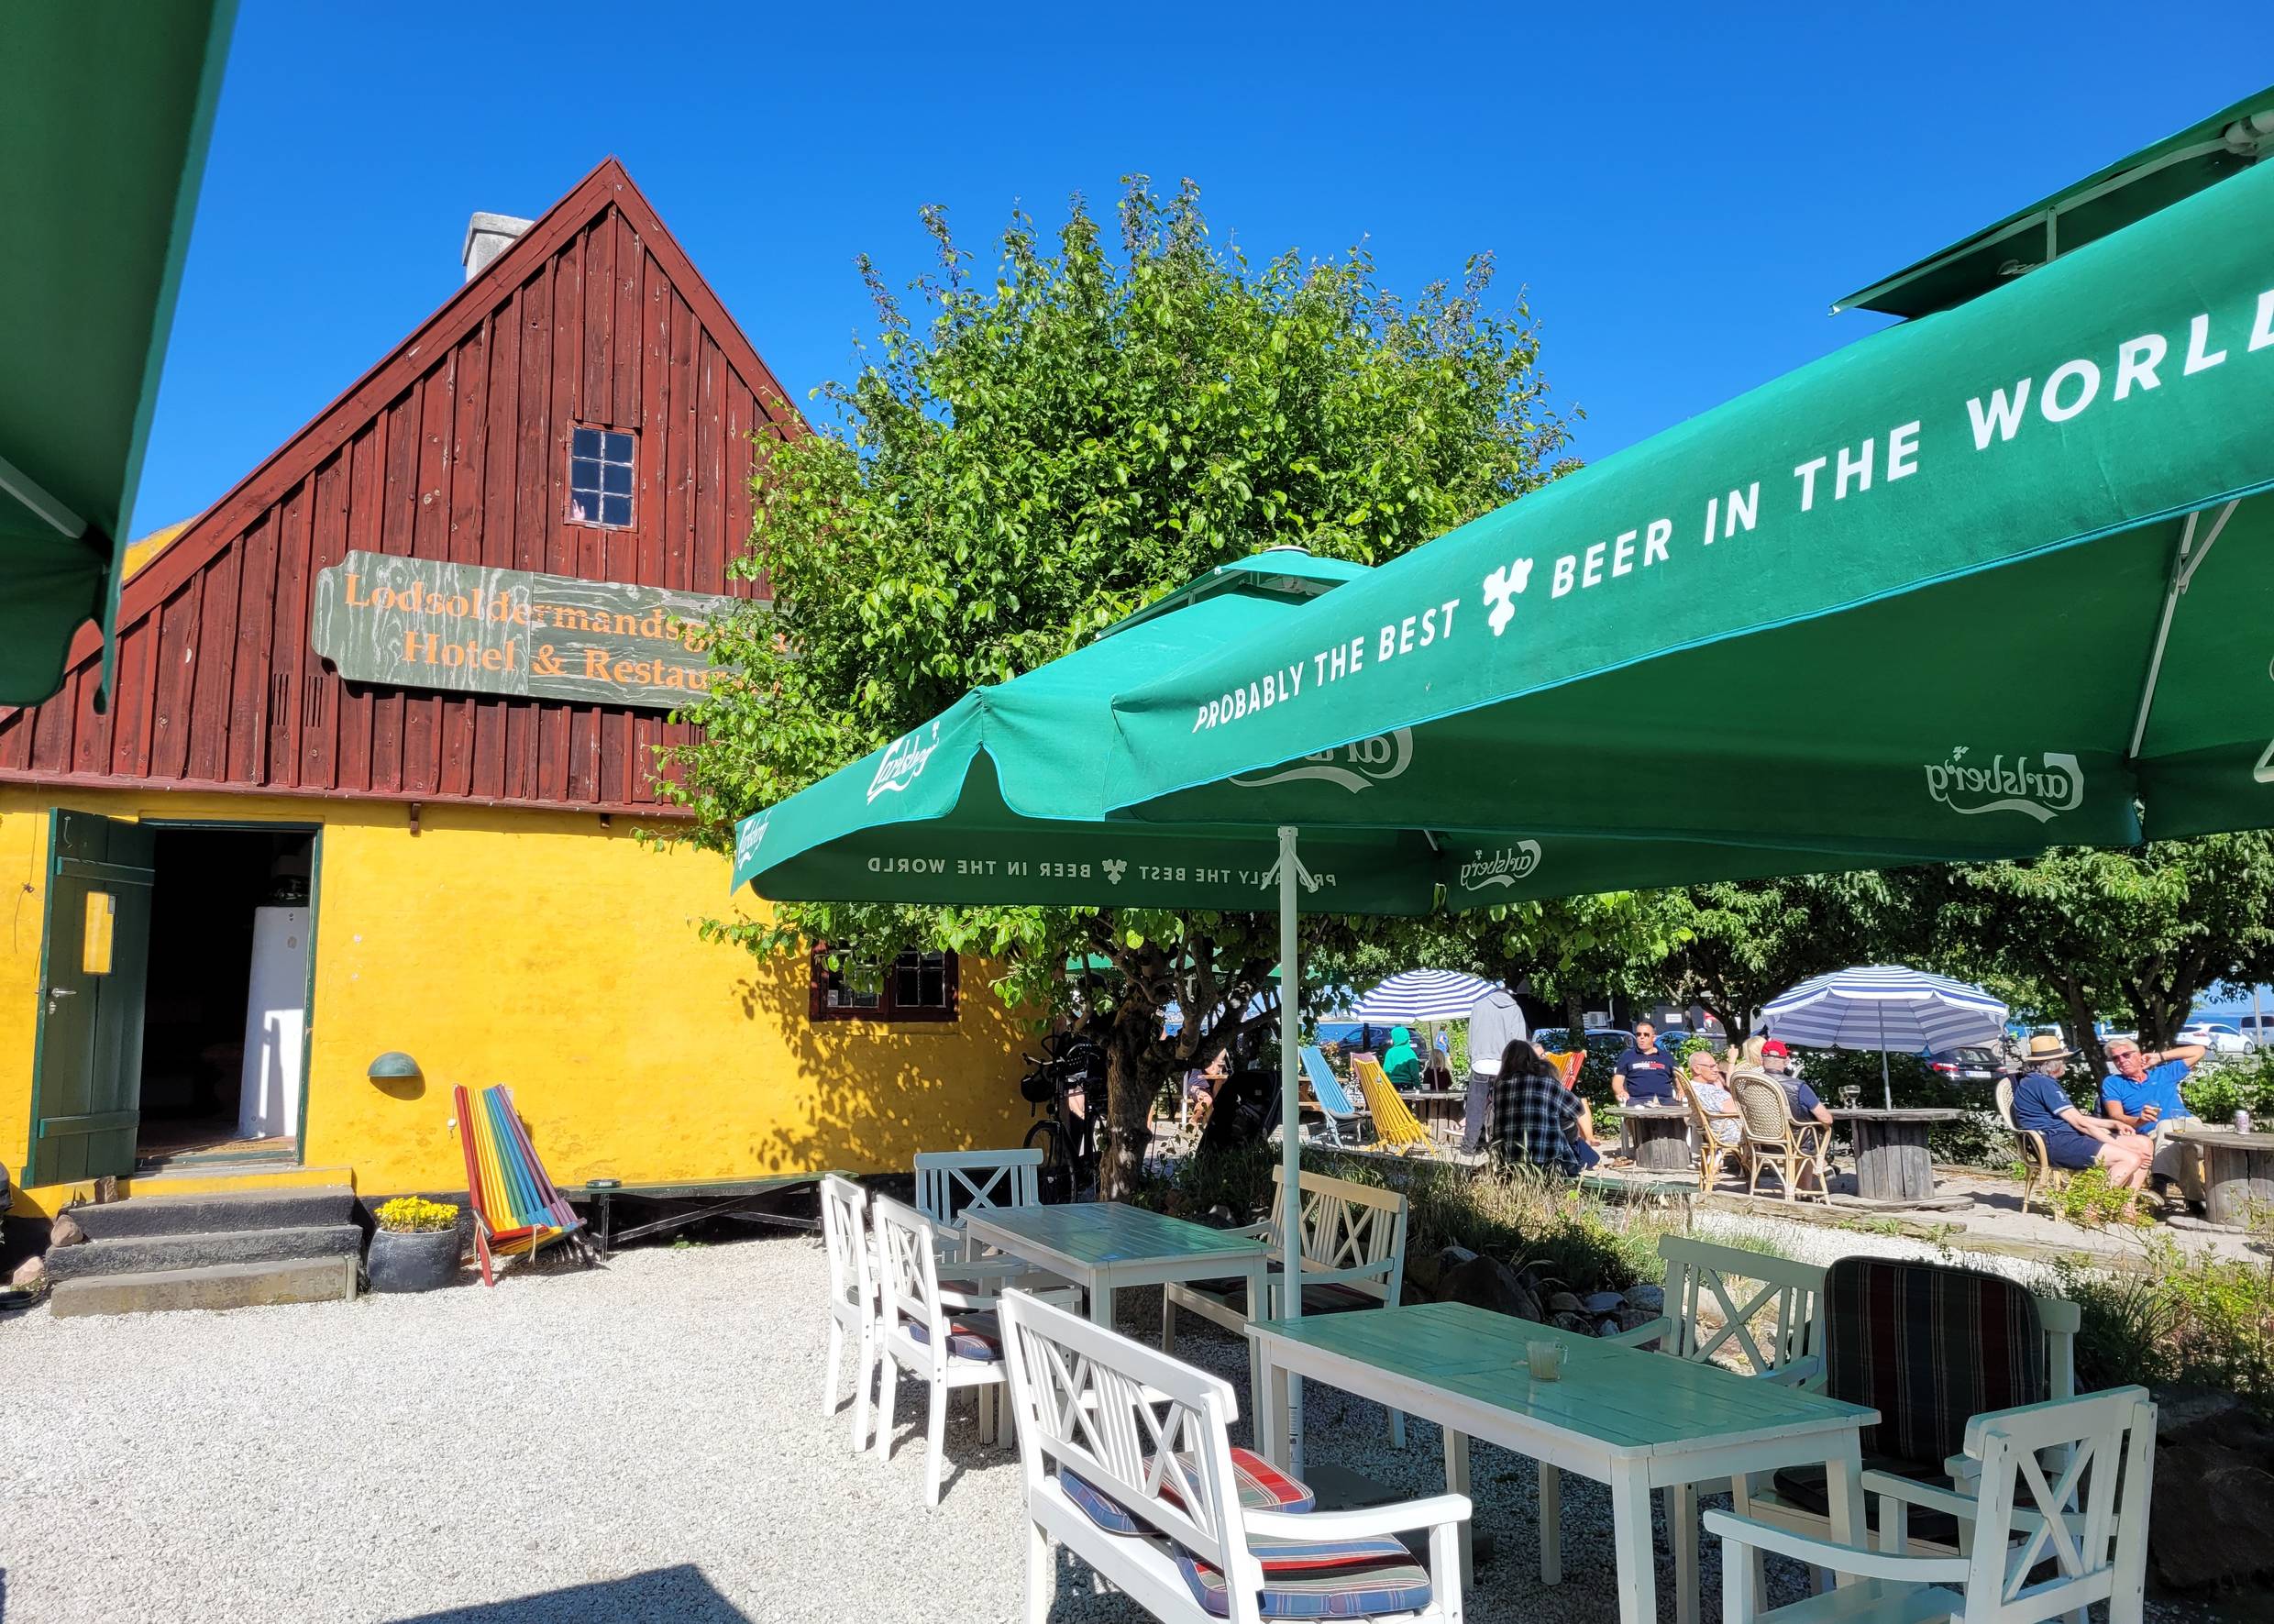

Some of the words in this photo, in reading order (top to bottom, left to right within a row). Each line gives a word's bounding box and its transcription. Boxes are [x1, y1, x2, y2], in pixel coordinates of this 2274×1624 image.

[402, 630, 515, 672] Hotel
[533, 644, 567, 676] &
[584, 647, 783, 696] Restau
[1191, 661, 1304, 734] PROBABLY
[1314, 635, 1364, 687] THE
[1377, 598, 1460, 662] BEST
[1551, 518, 1672, 599] BEER
[1704, 481, 1760, 546] IN
[1794, 420, 1921, 512] THE
